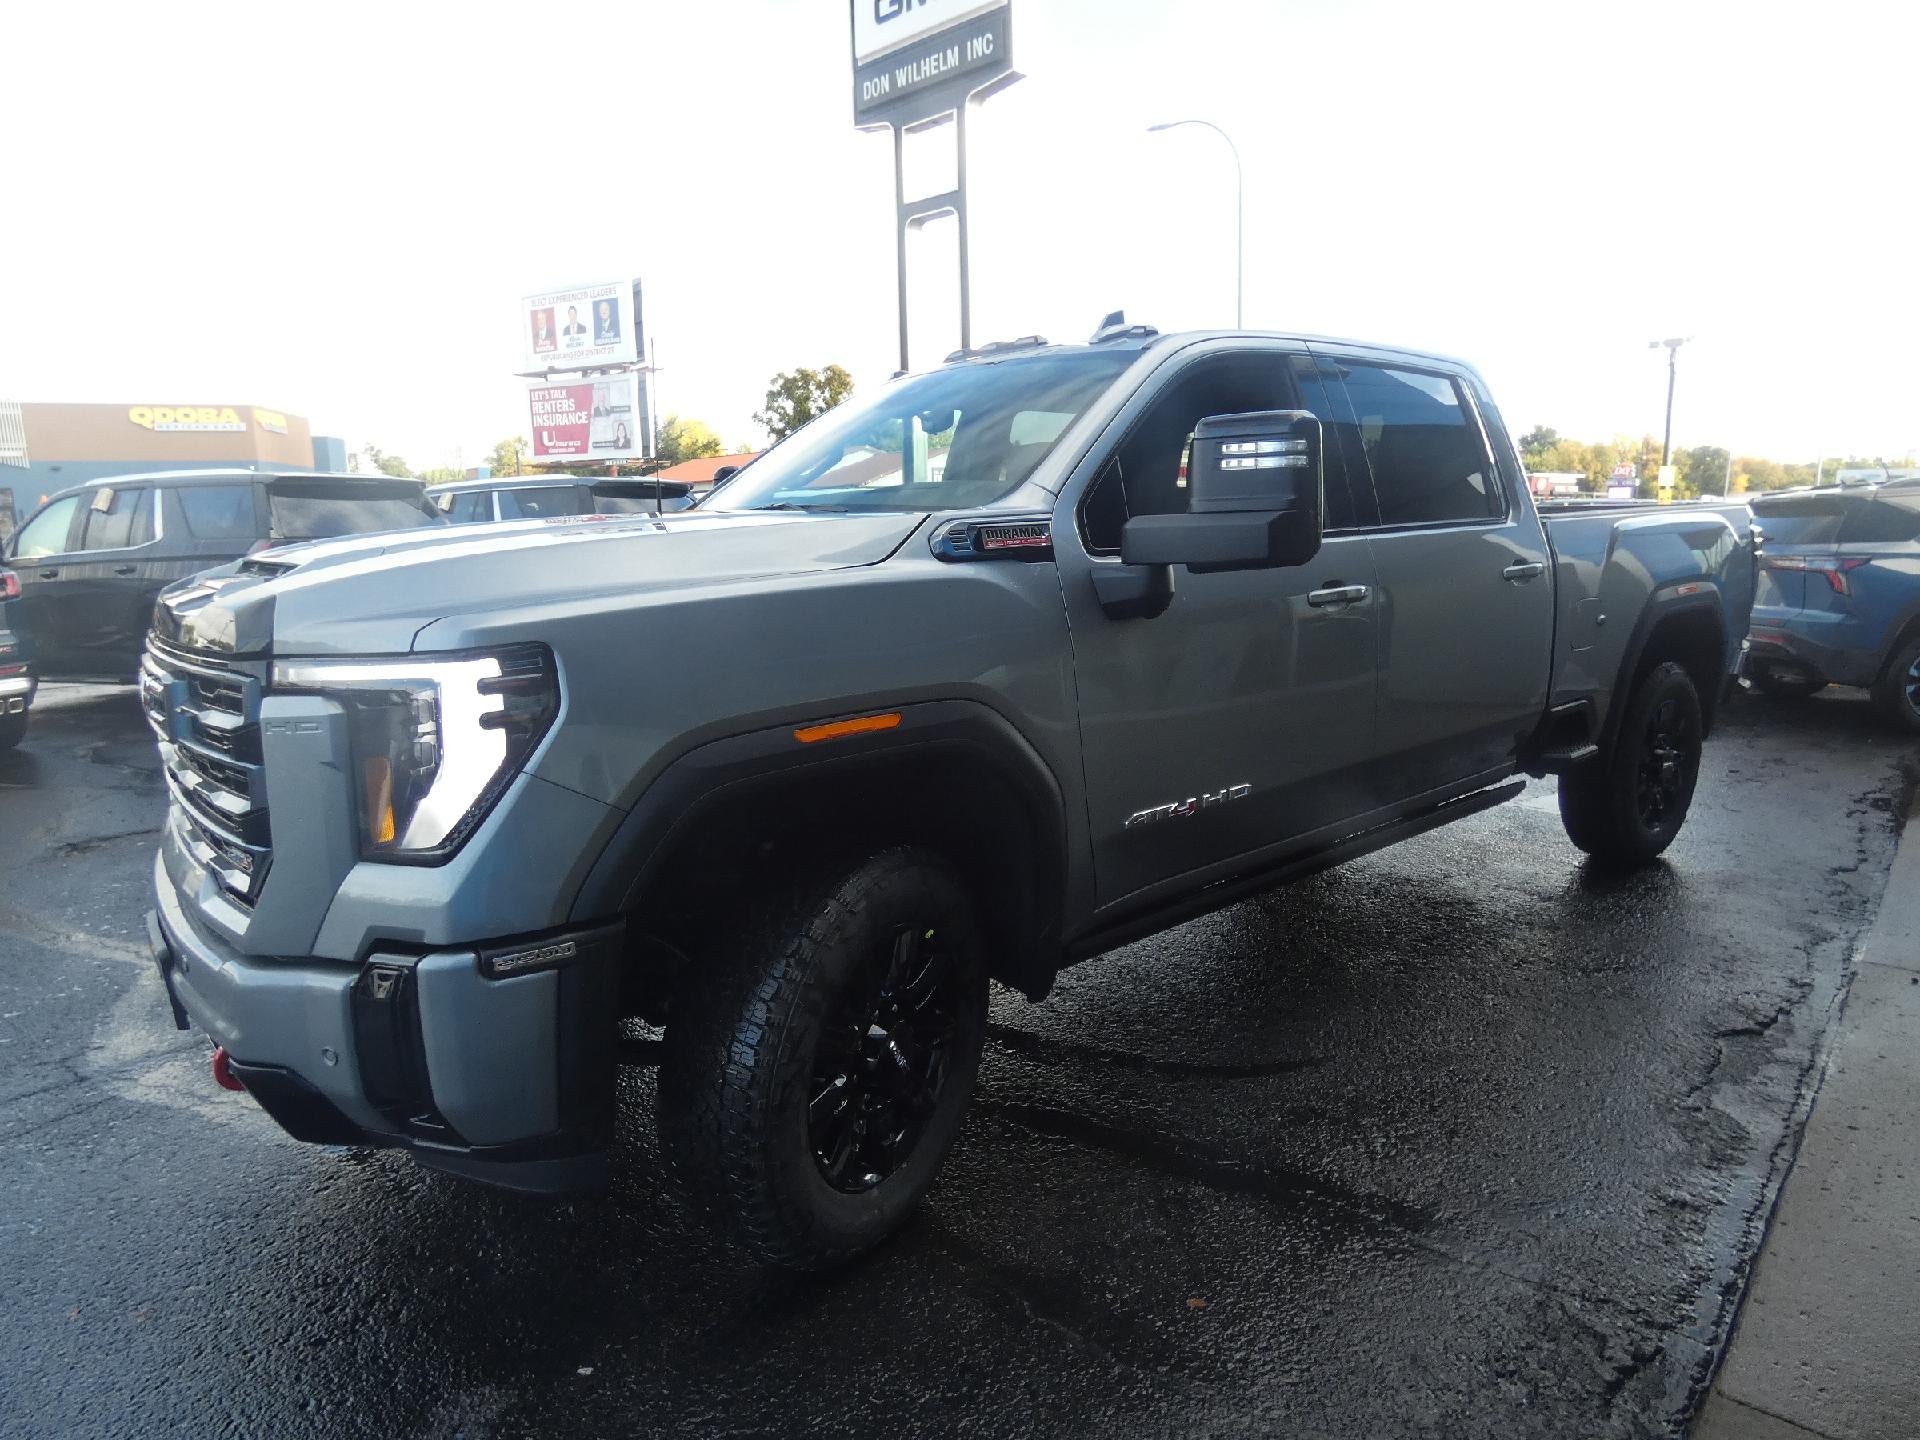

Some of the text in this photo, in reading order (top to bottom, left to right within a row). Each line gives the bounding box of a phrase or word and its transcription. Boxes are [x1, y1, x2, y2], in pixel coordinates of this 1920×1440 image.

[863, 33, 994, 101] DON WILHELM INC
[589, 287, 617, 299] LEADERS
[531, 389, 567, 401] LET'S TALK
[532, 398, 576, 414] RENTERS
[128, 406, 241, 430] QDOBA
[533, 411, 589, 427] INSURANCE
[986, 527, 1046, 539] DURAMAX
